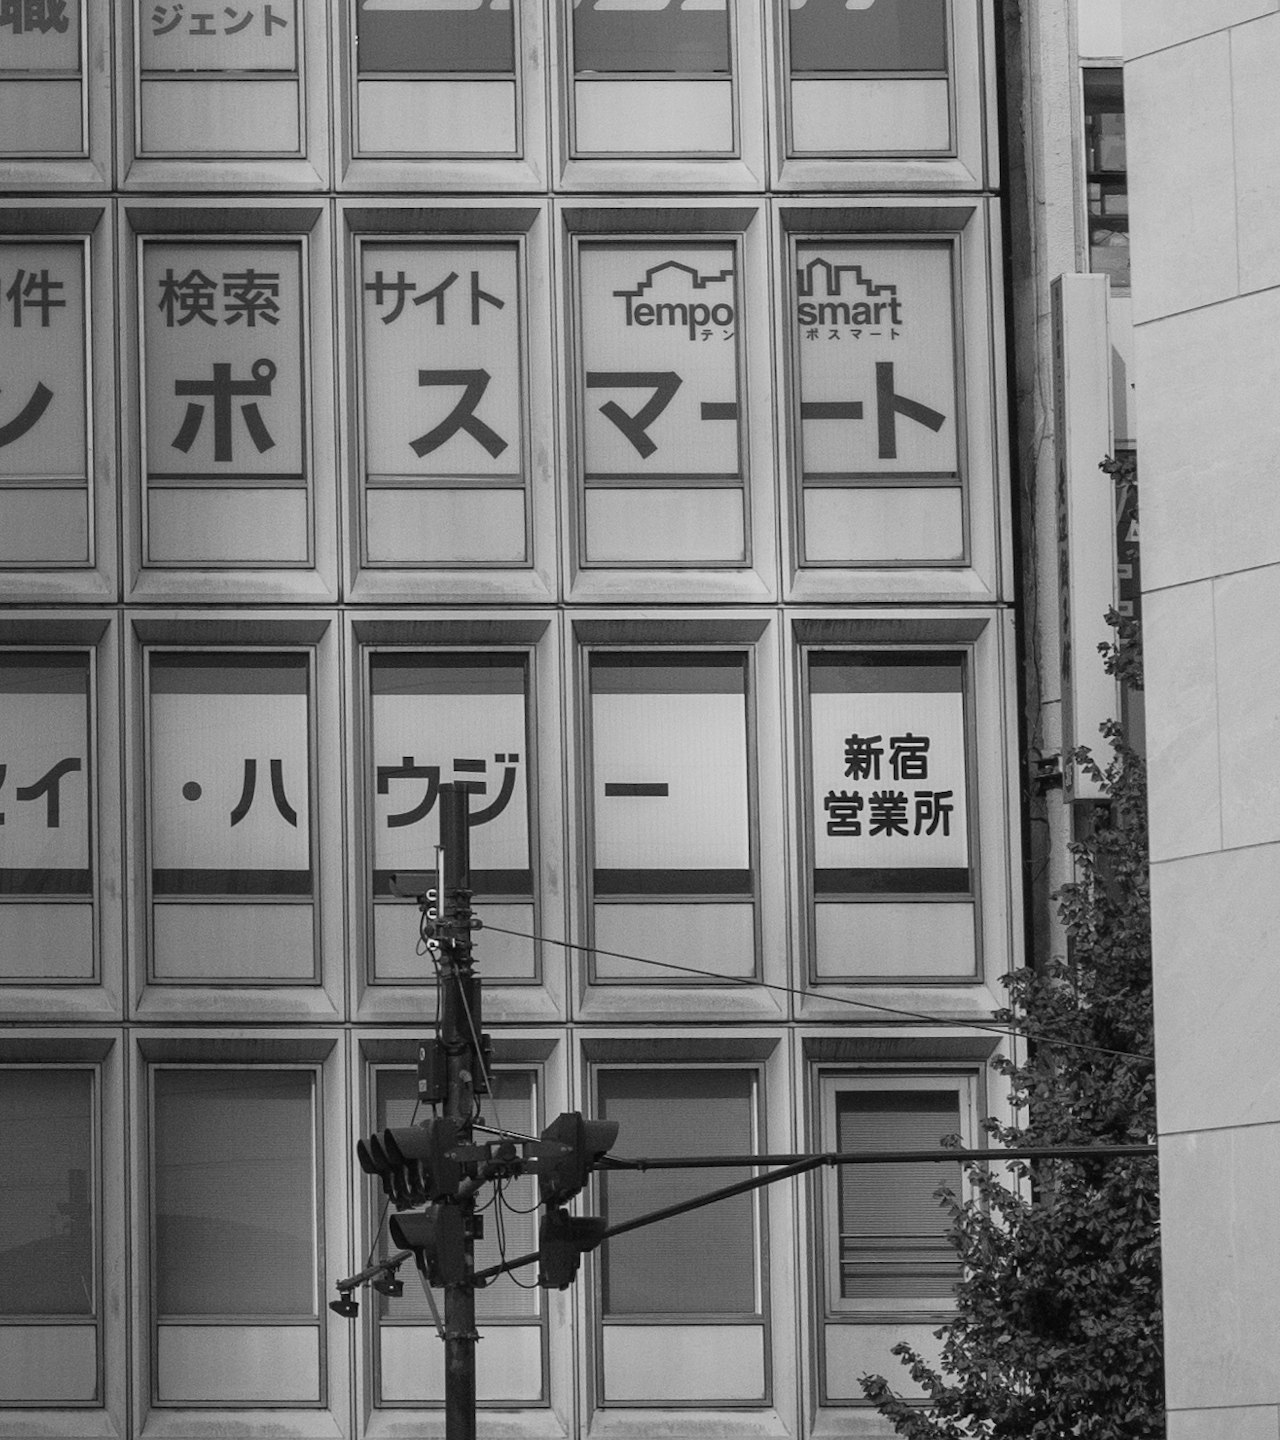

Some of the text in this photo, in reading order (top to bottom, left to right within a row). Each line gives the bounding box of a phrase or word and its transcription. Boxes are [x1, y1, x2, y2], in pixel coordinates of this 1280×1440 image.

[842, 733, 931, 780] 新宿
[822, 788, 954, 838] 営業所
